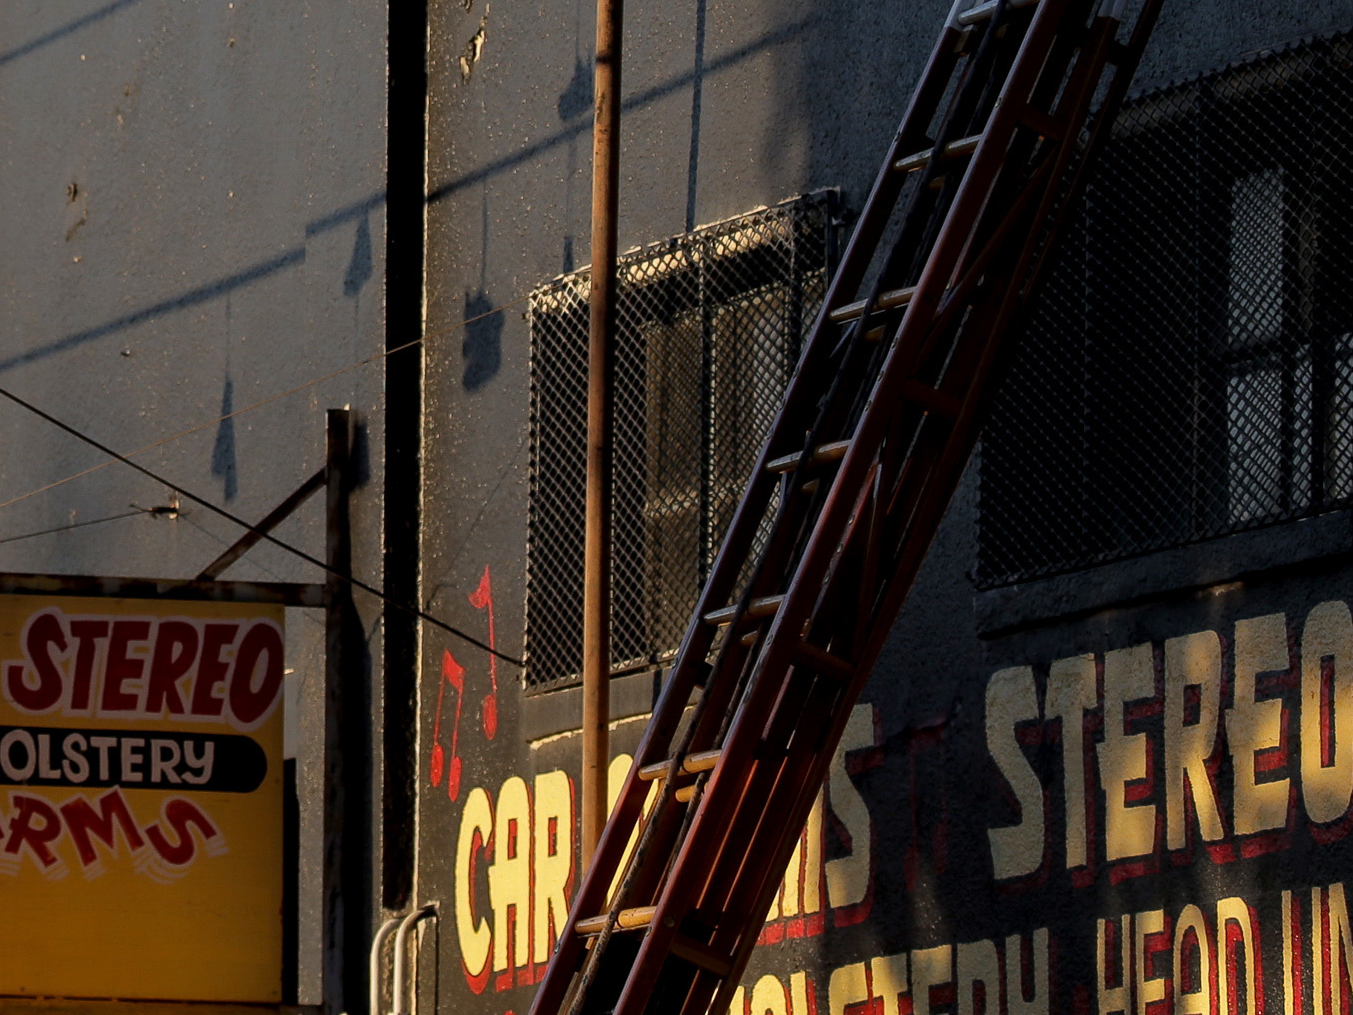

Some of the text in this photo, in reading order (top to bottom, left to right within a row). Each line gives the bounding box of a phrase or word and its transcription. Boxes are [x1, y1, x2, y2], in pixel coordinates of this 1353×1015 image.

[3, 607, 285, 728] STEREO
[454, 769, 573, 979] CAR
[984, 599, 1353, 882] STEREO
